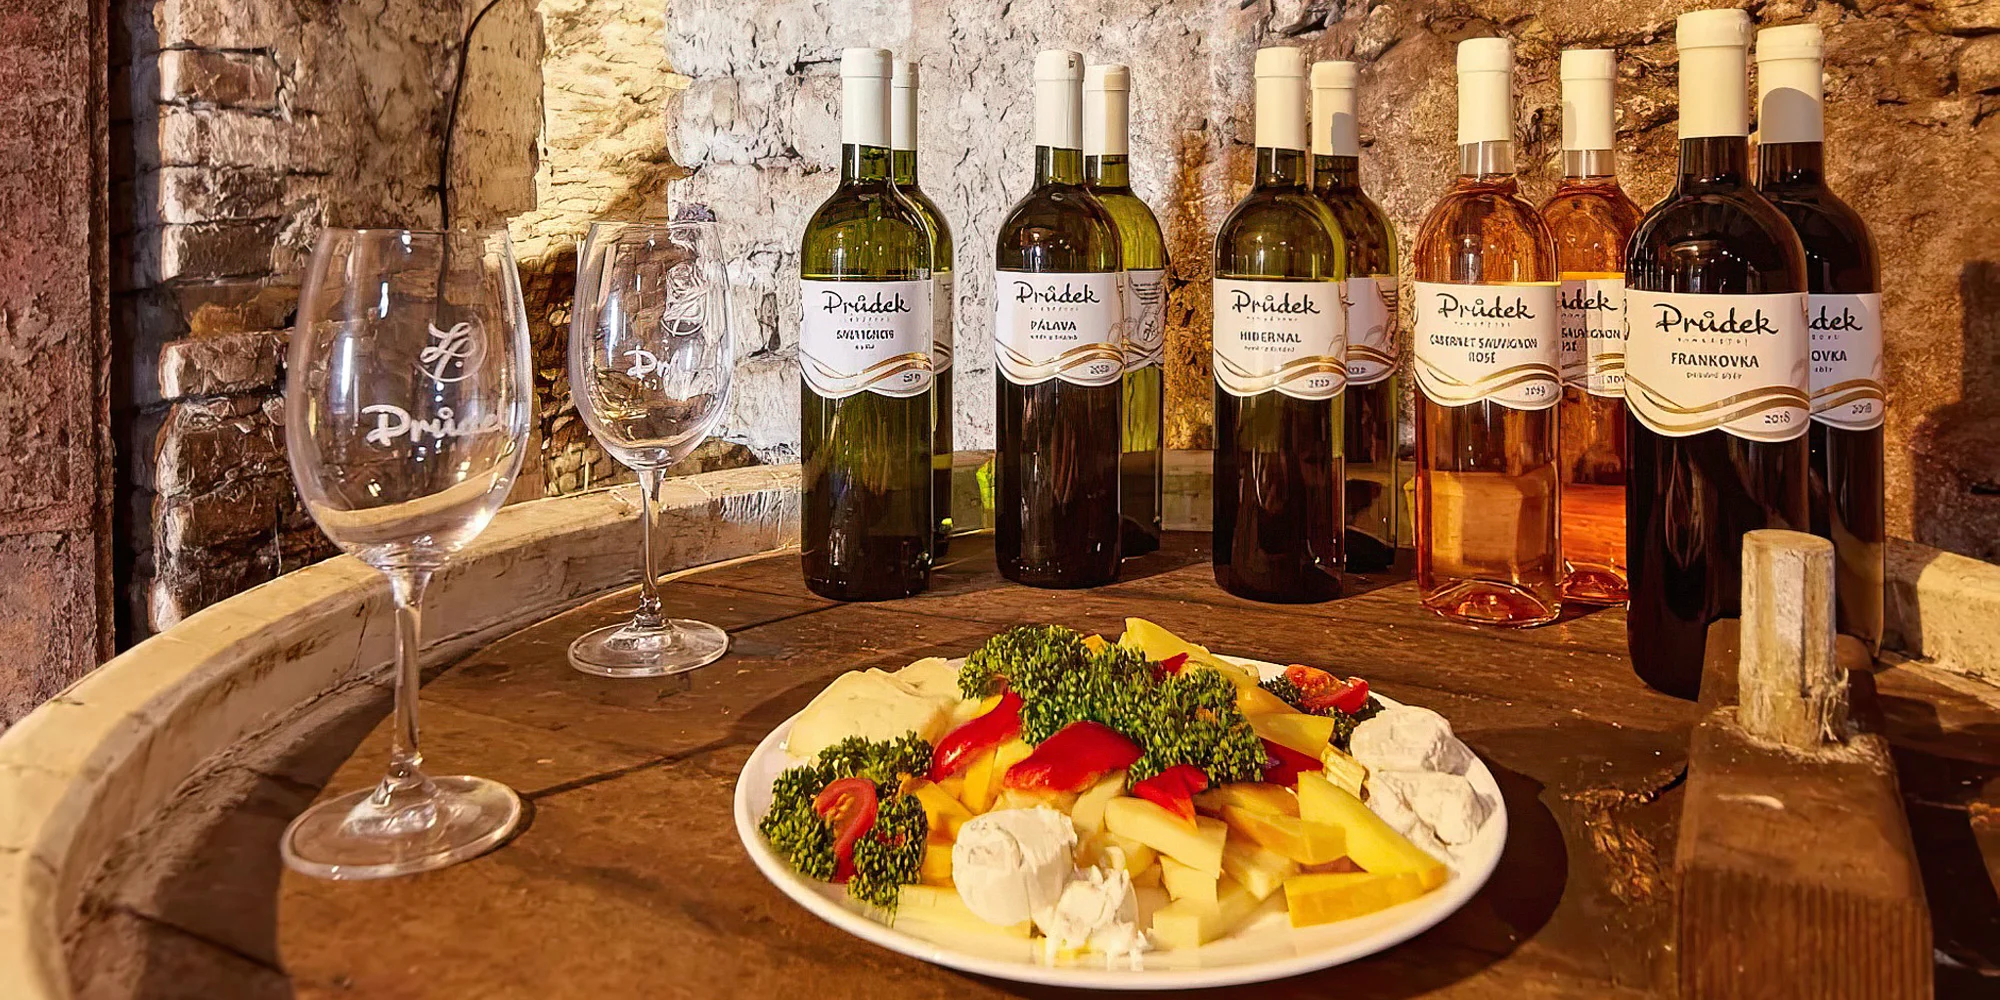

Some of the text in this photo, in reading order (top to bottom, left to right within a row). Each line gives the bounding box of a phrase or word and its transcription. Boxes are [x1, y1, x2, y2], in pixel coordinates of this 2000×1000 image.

[821, 290, 911, 314] Průdek
[1013, 281, 1101, 304] Průdek
[1231, 289, 1321, 314] Průdek
[1436, 292, 1535, 319] Průdek
[1653, 303, 1779, 335] Průdek
[1671, 352, 1760, 368] FRANKOVKA
[1764, 410, 1792, 425] 2018
